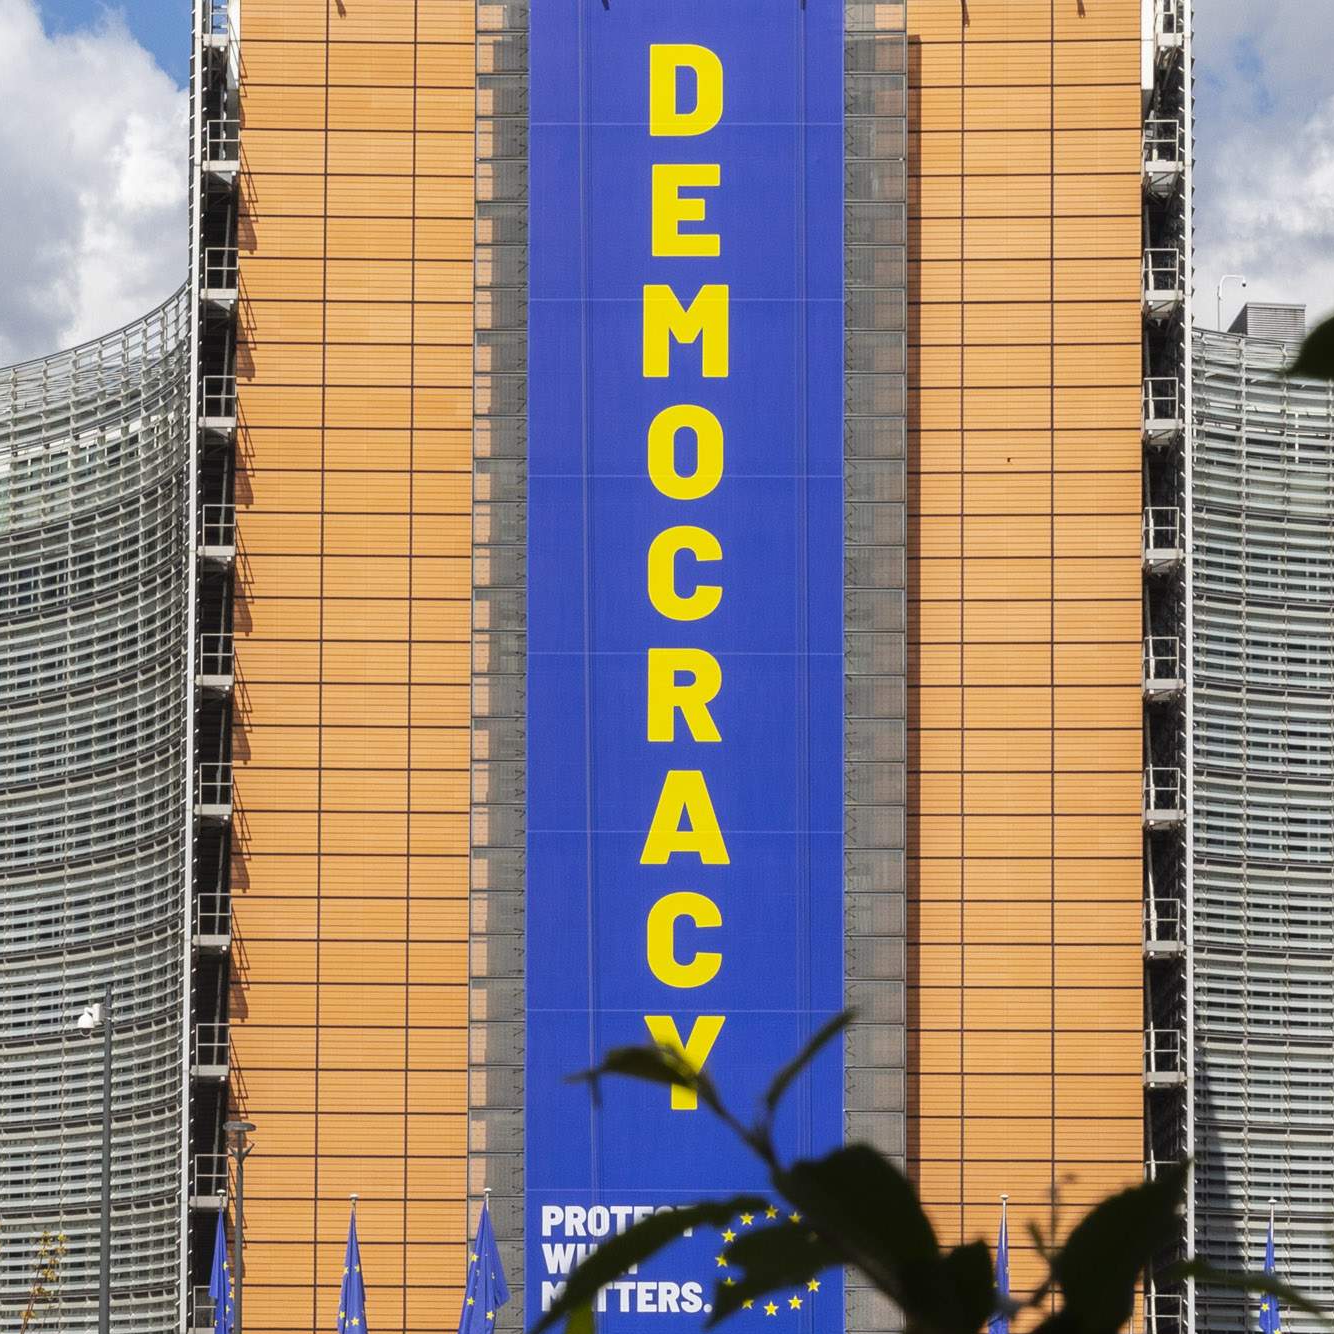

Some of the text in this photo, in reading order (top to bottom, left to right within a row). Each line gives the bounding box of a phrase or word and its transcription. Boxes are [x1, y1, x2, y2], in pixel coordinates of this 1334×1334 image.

[640, 43, 730, 1110] DEMOCRACY
[541, 1205, 698, 1237] PROTE
[541, 1243, 639, 1275] WH
[541, 1281, 713, 1313] MTTERS.
